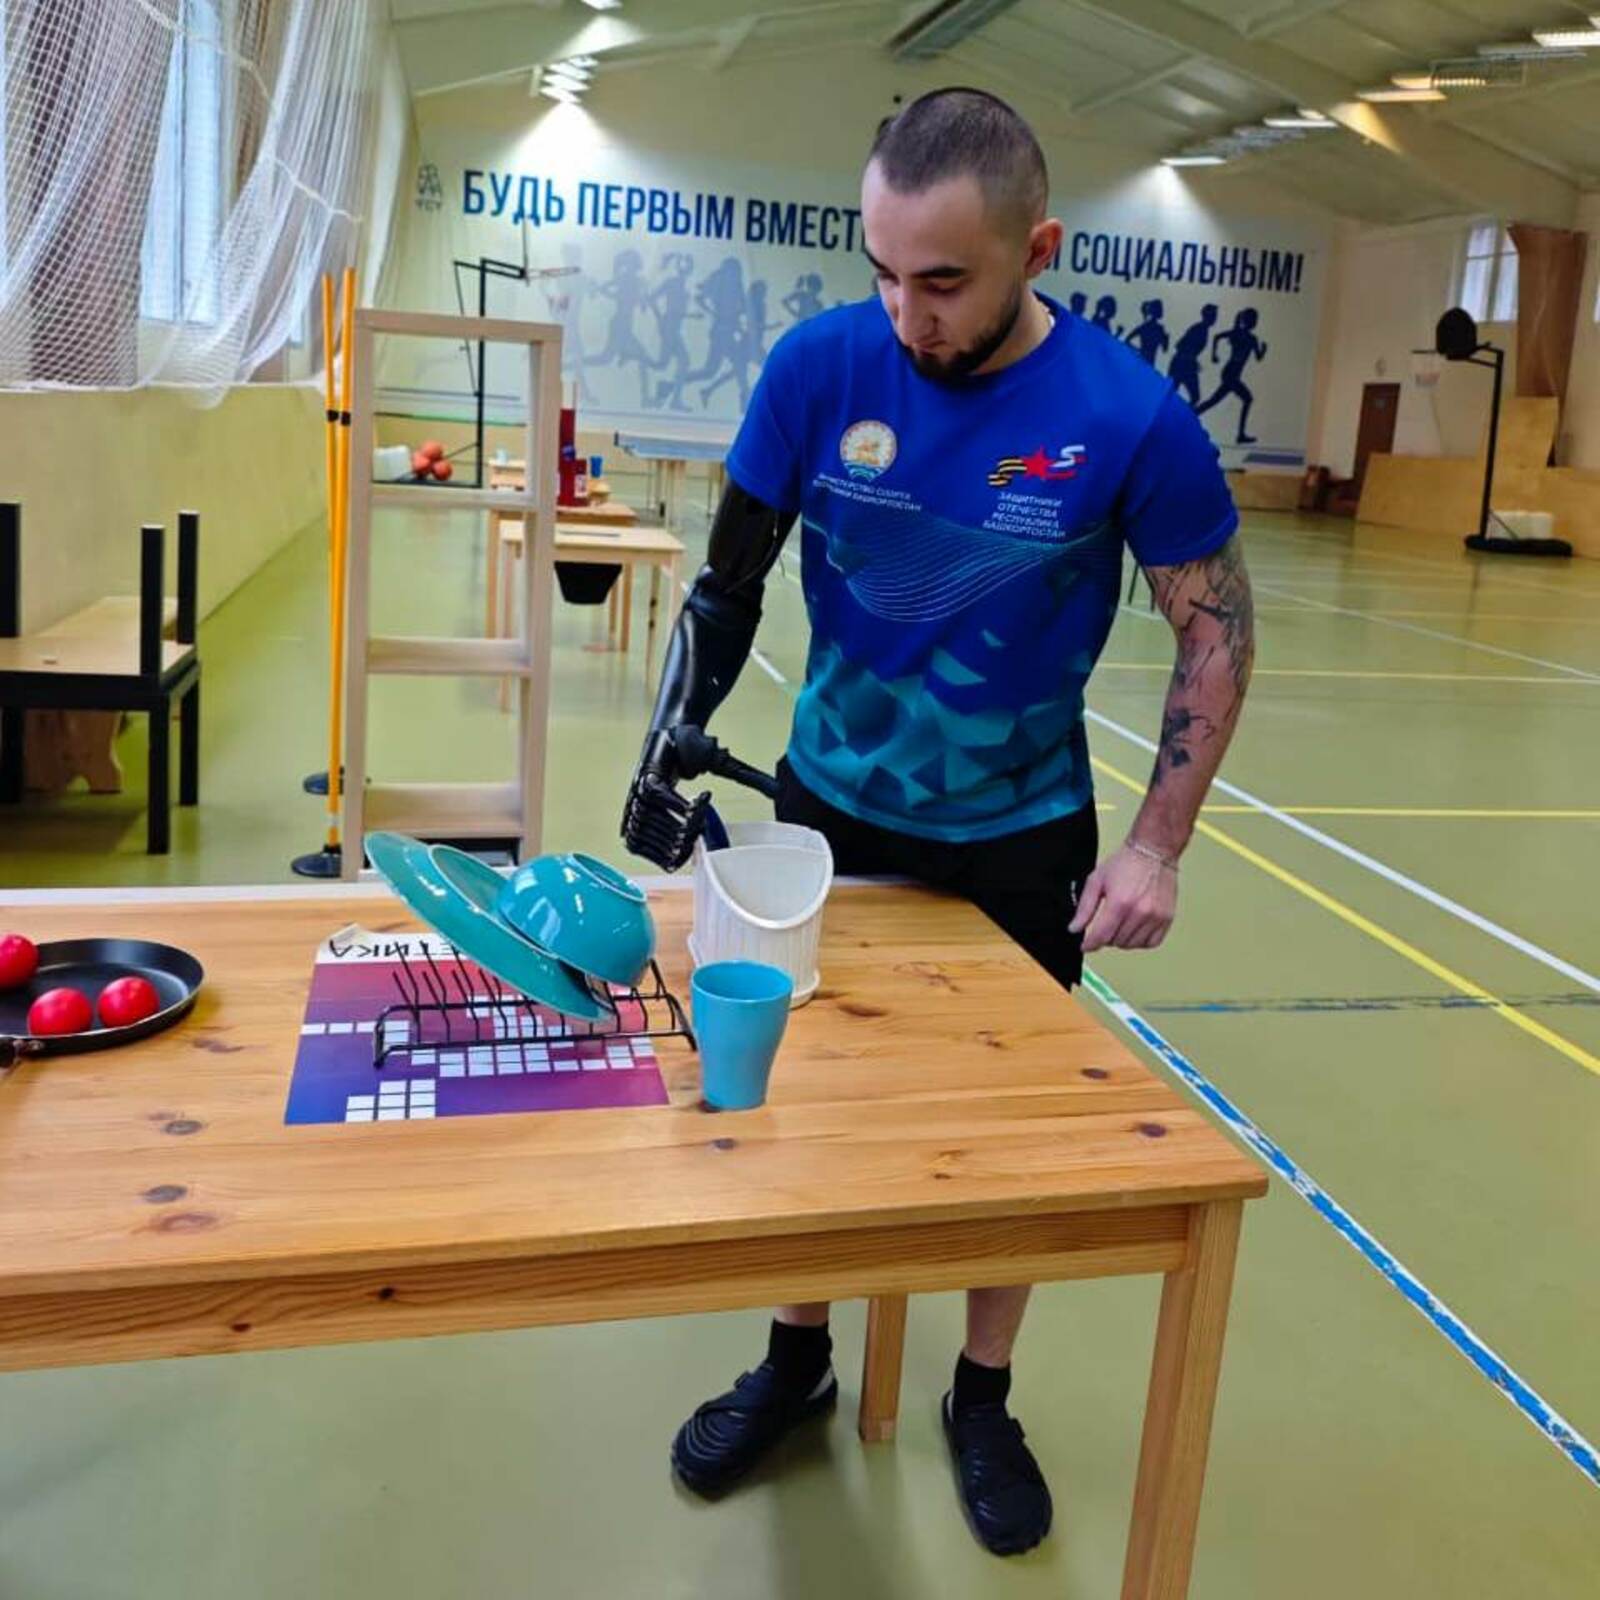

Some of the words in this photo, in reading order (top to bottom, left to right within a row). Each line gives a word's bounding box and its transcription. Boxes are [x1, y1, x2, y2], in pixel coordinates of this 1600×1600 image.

[463, 169, 565, 227] БУДЬ
[576, 182, 735, 240] ПЕРВЫМ
[745, 199, 863, 253] ВМЕСТ
[1071, 231, 1304, 294] СОЦИАЛЬНЫМ!
